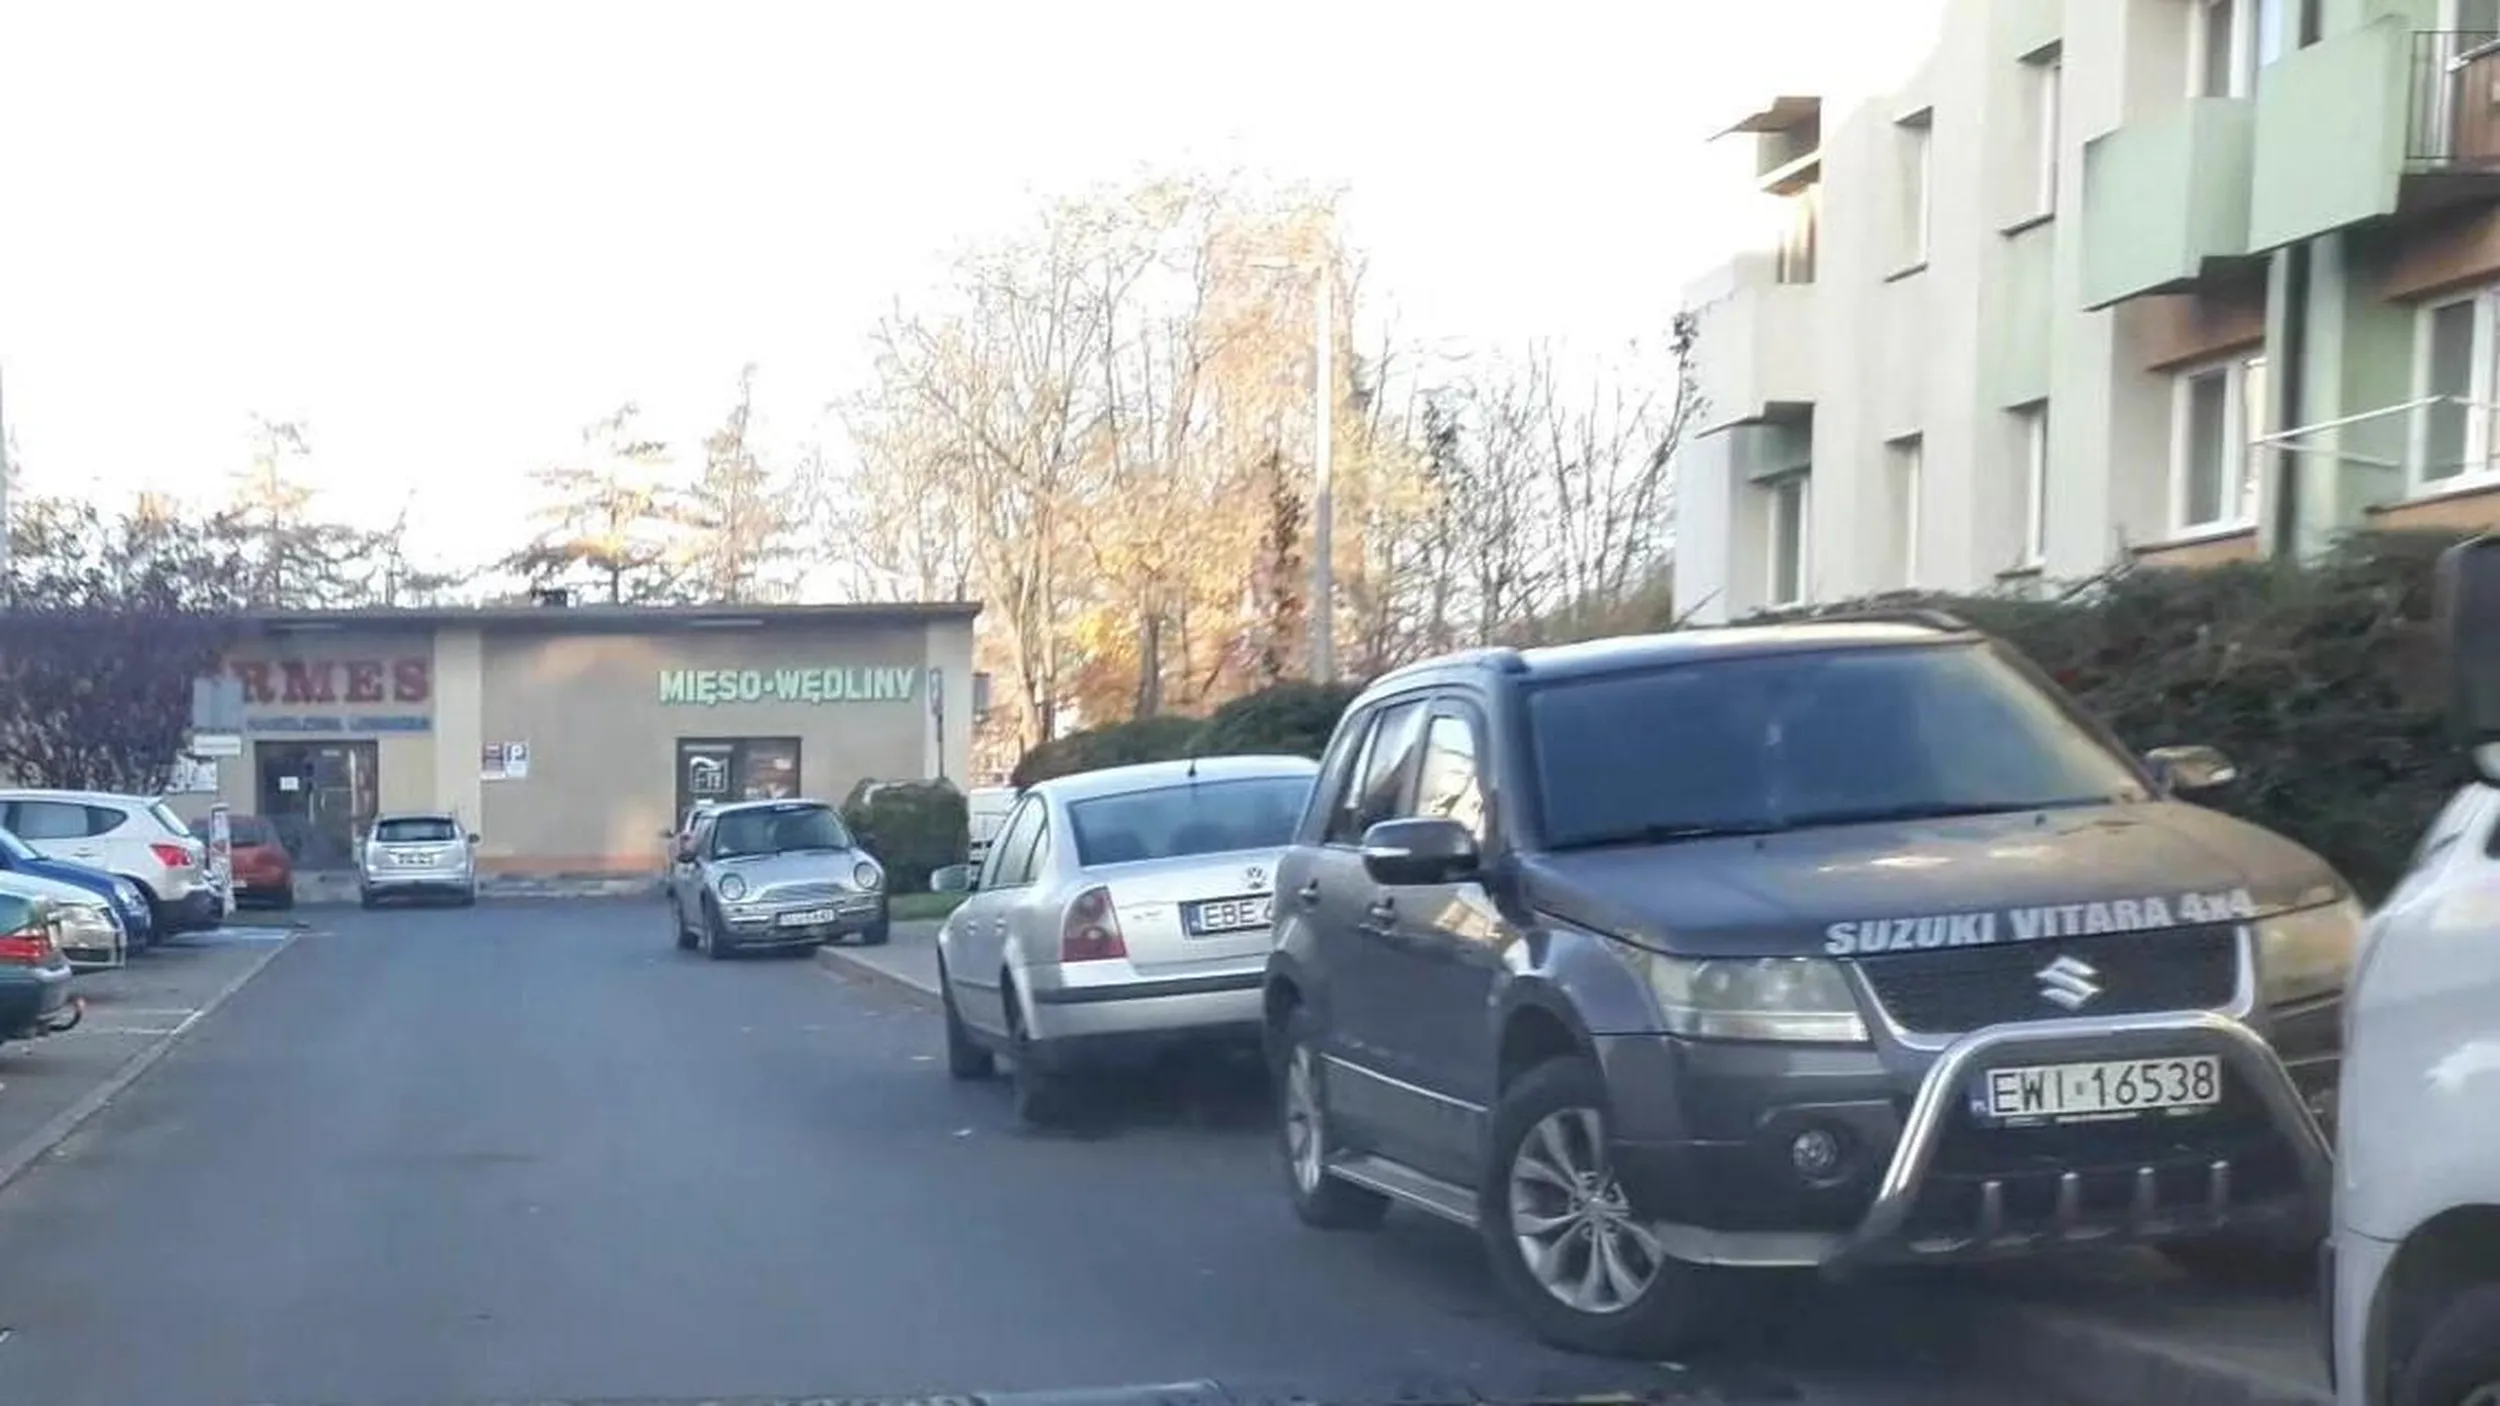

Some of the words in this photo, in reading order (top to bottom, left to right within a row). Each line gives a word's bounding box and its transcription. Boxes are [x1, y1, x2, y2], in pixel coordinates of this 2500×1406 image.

[1205, 901, 1255, 927] EBE
[1826, 912, 1996, 954] SUZUKI
[2009, 896, 2173, 941] VITARA
[2179, 888, 2256, 922] 4x4
[1993, 1068, 2065, 1113] EWI
[2090, 1060, 2215, 1108] 16538
